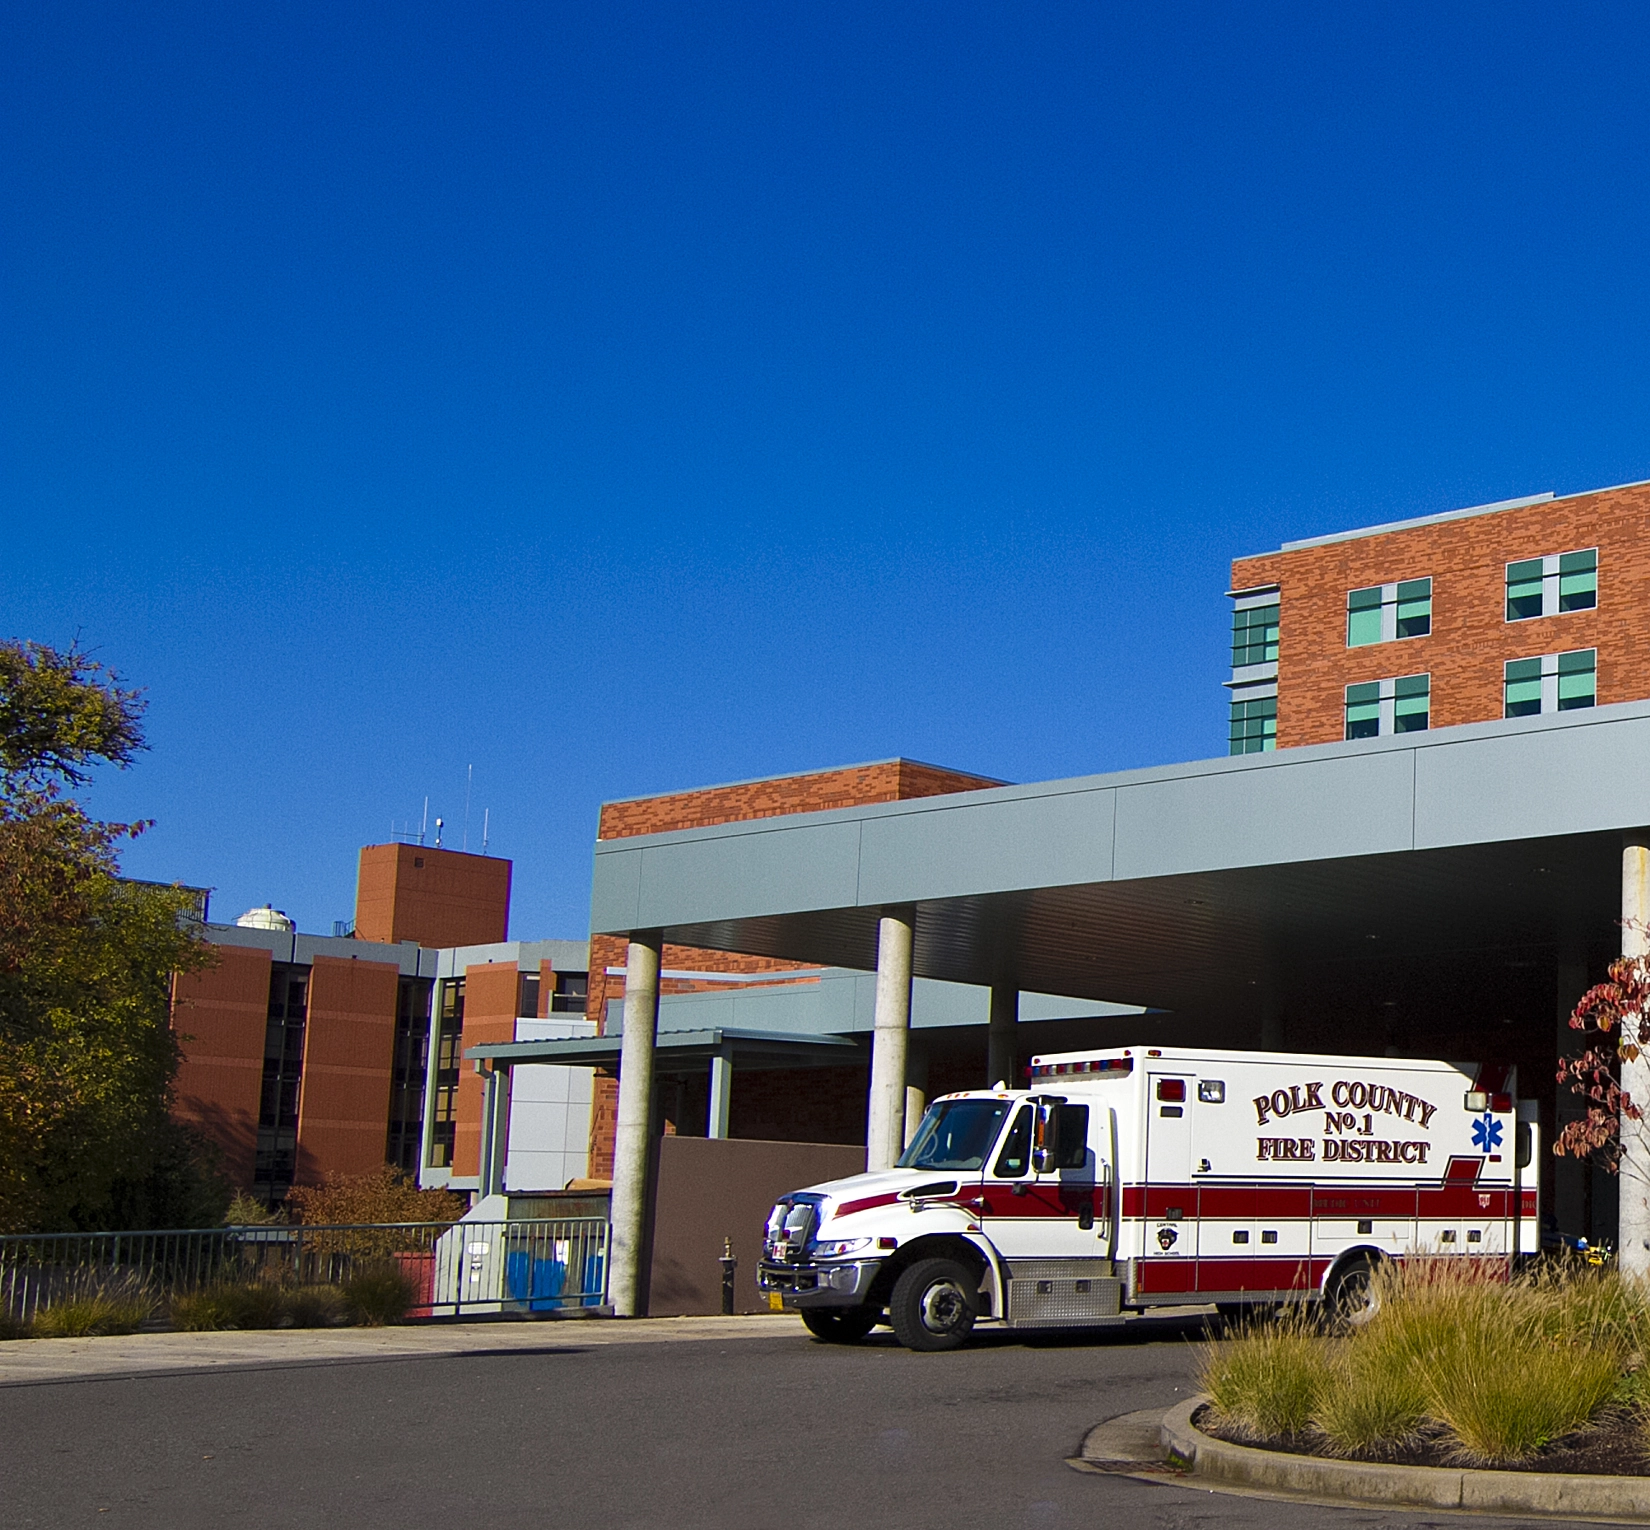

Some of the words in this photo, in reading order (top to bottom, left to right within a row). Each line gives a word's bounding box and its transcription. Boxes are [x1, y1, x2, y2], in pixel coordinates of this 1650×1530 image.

[1252, 1081, 1326, 1126] POLK
[1331, 1080, 1437, 1129] COUNTY
[1256, 1137, 1315, 1161] FIRE
[1322, 1138, 1431, 1164] DISTRICT
